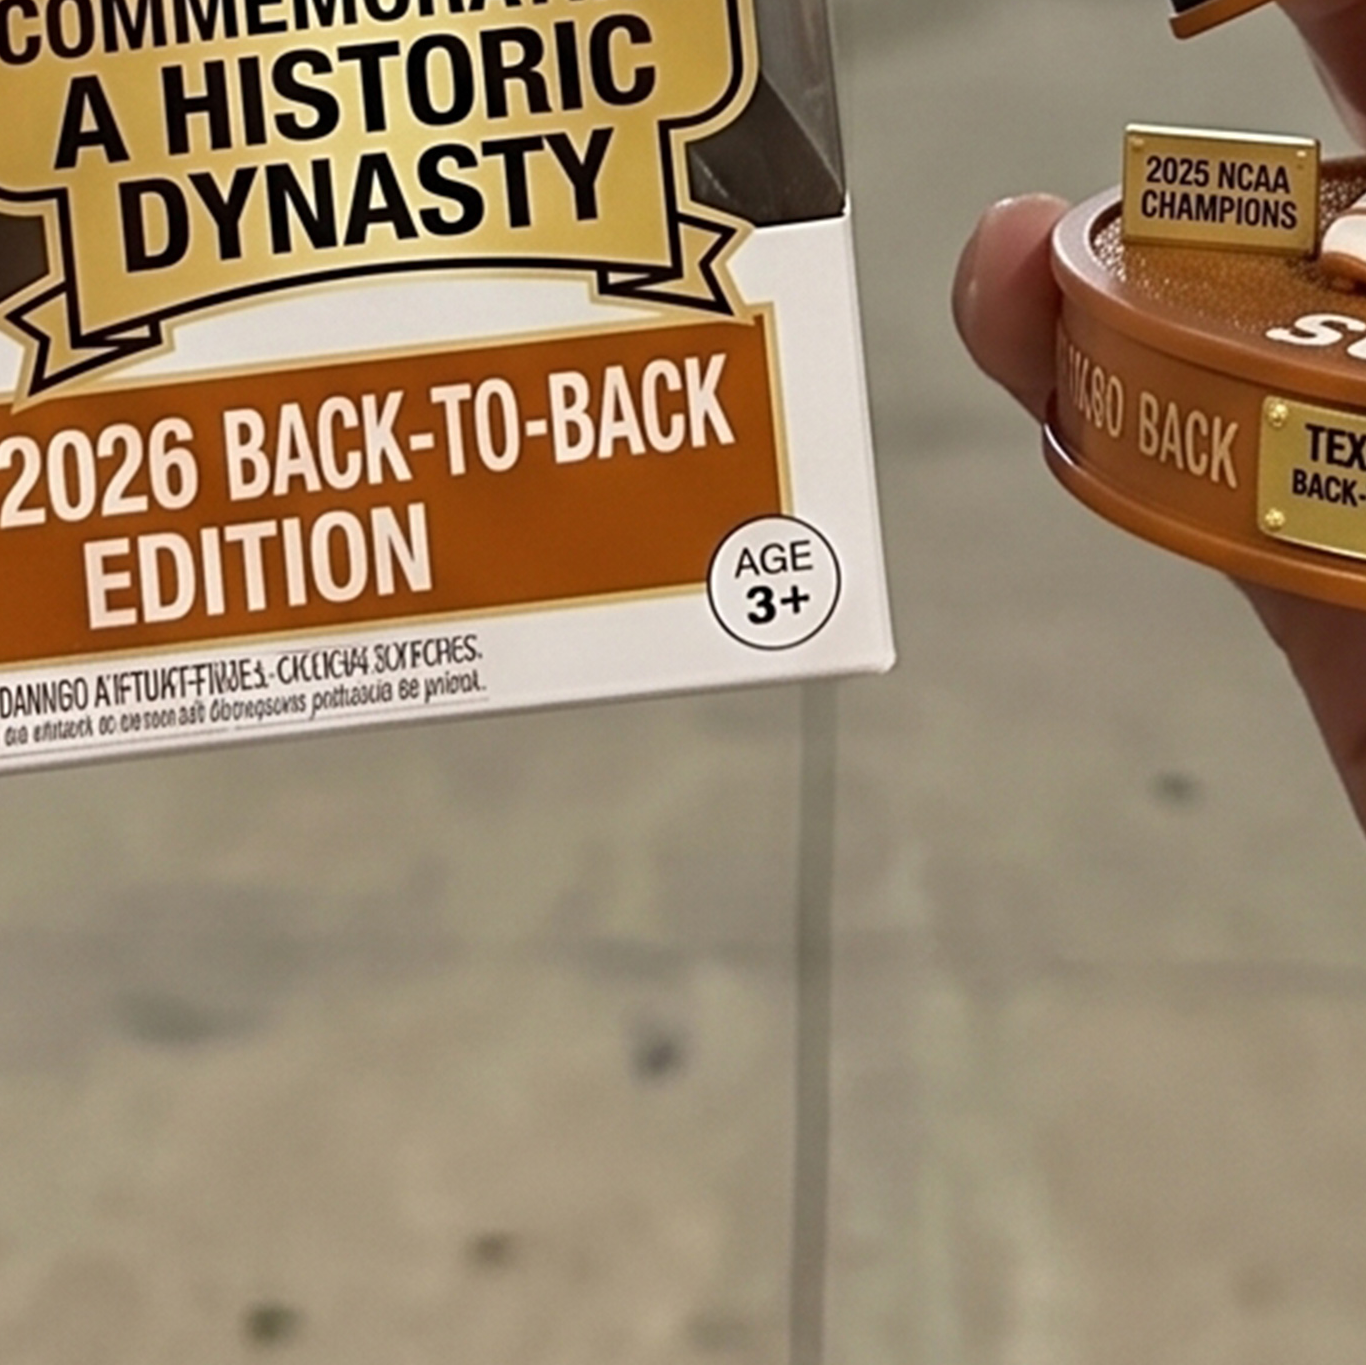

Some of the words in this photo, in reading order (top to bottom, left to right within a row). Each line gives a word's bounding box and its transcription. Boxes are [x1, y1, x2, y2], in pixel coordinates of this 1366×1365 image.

[53, 75, 129, 169] A
[161, 13, 657, 156] HISTORIC
[118, 127, 614, 274] DYNASTY
[1140, 189, 1298, 230] CHAMPIONS
[1146, 156, 1210, 188] 2025
[1217, 161, 1290, 195] NCAA
[224, 354, 735, 503] BACK-TO-BACK
[1139, 391, 1238, 488] BACK
[83, 502, 433, 629] EDITION
[735, 540, 813, 579] AGE
[746, 585, 810, 625] 3+
